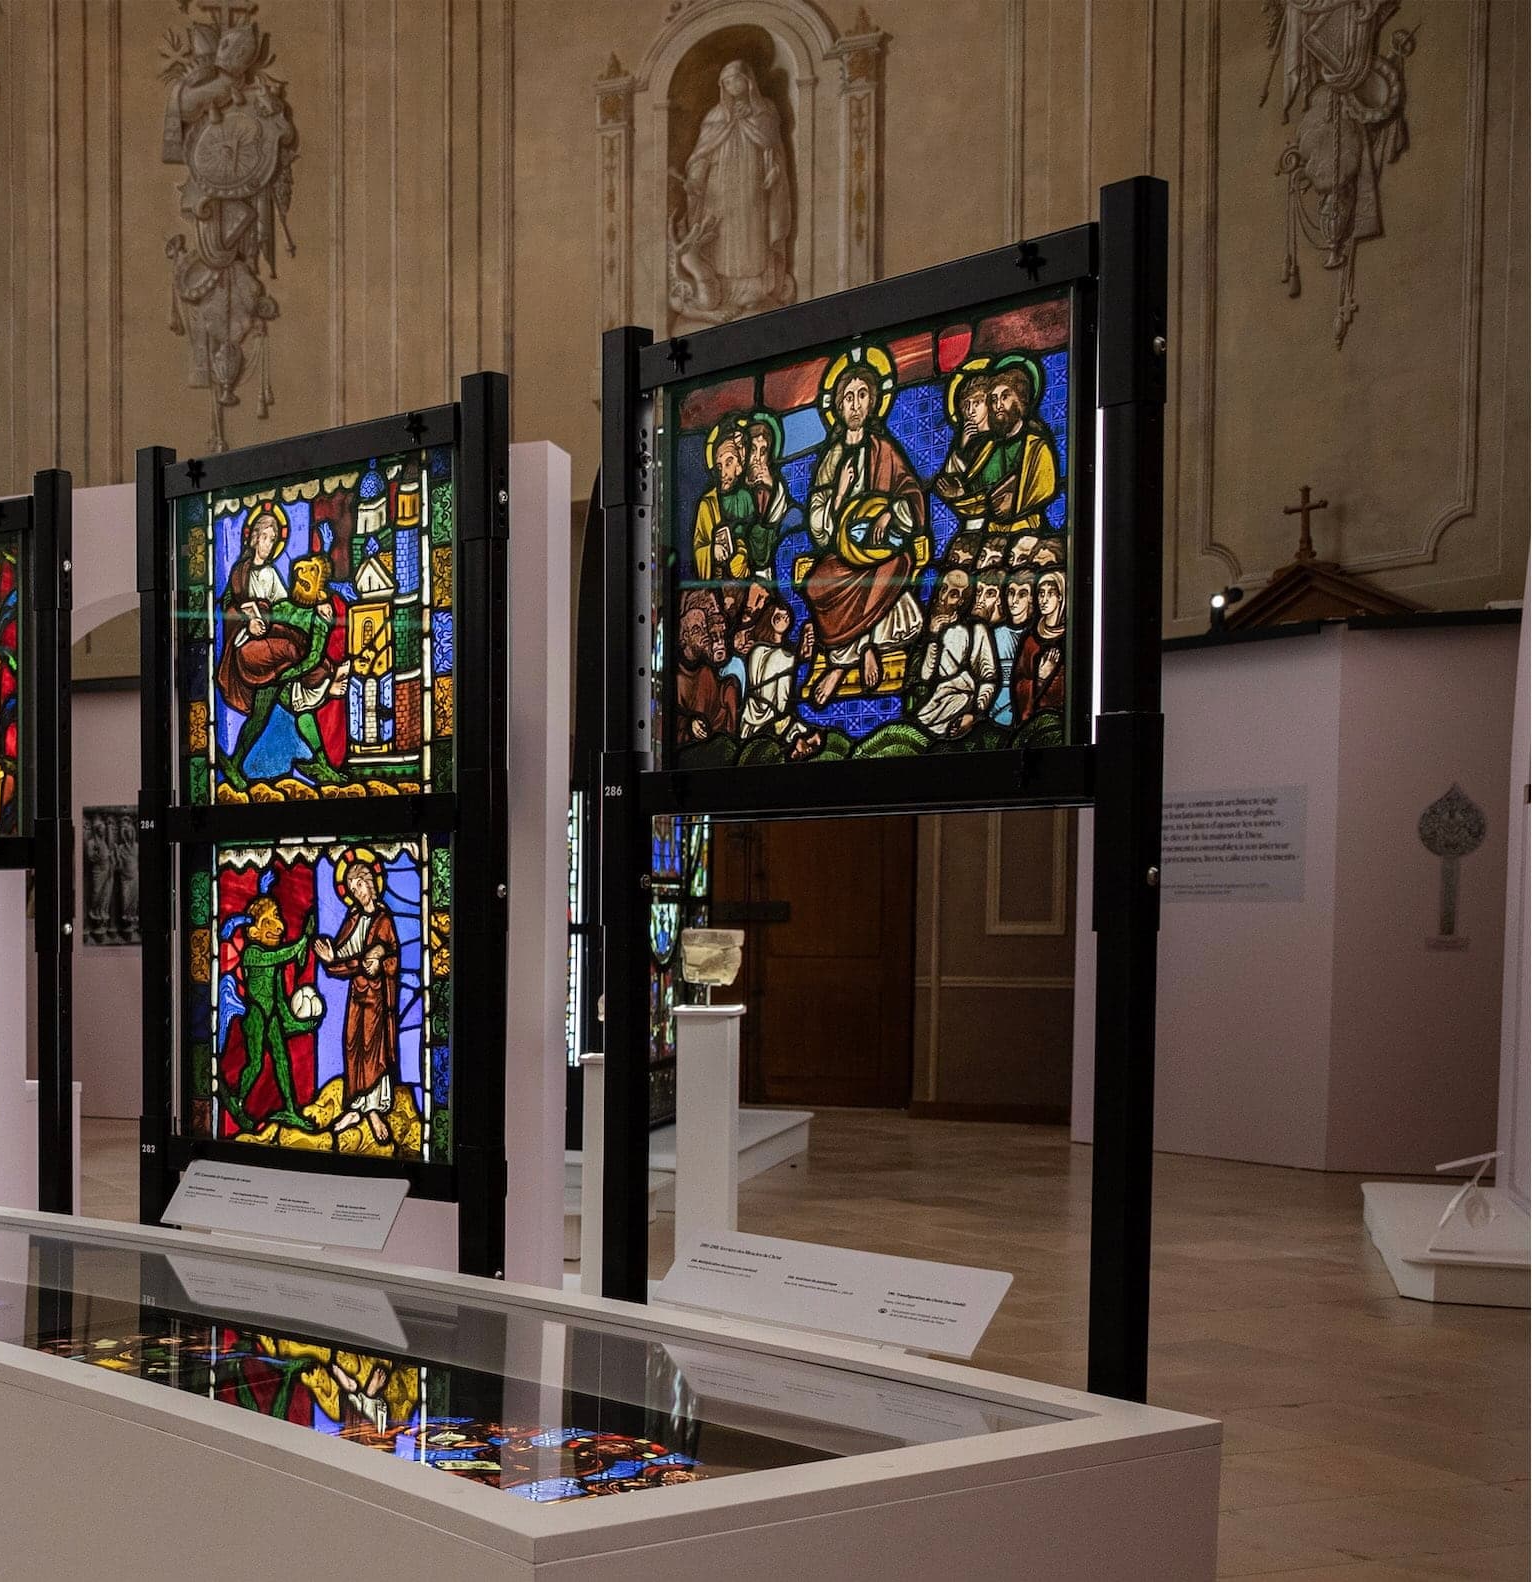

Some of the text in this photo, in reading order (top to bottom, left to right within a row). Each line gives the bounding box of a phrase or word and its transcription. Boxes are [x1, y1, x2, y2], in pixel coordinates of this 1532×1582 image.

[604, 785, 623, 797] 286
[140, 820, 154, 830] 284
[141, 1143, 156, 1153] 282
